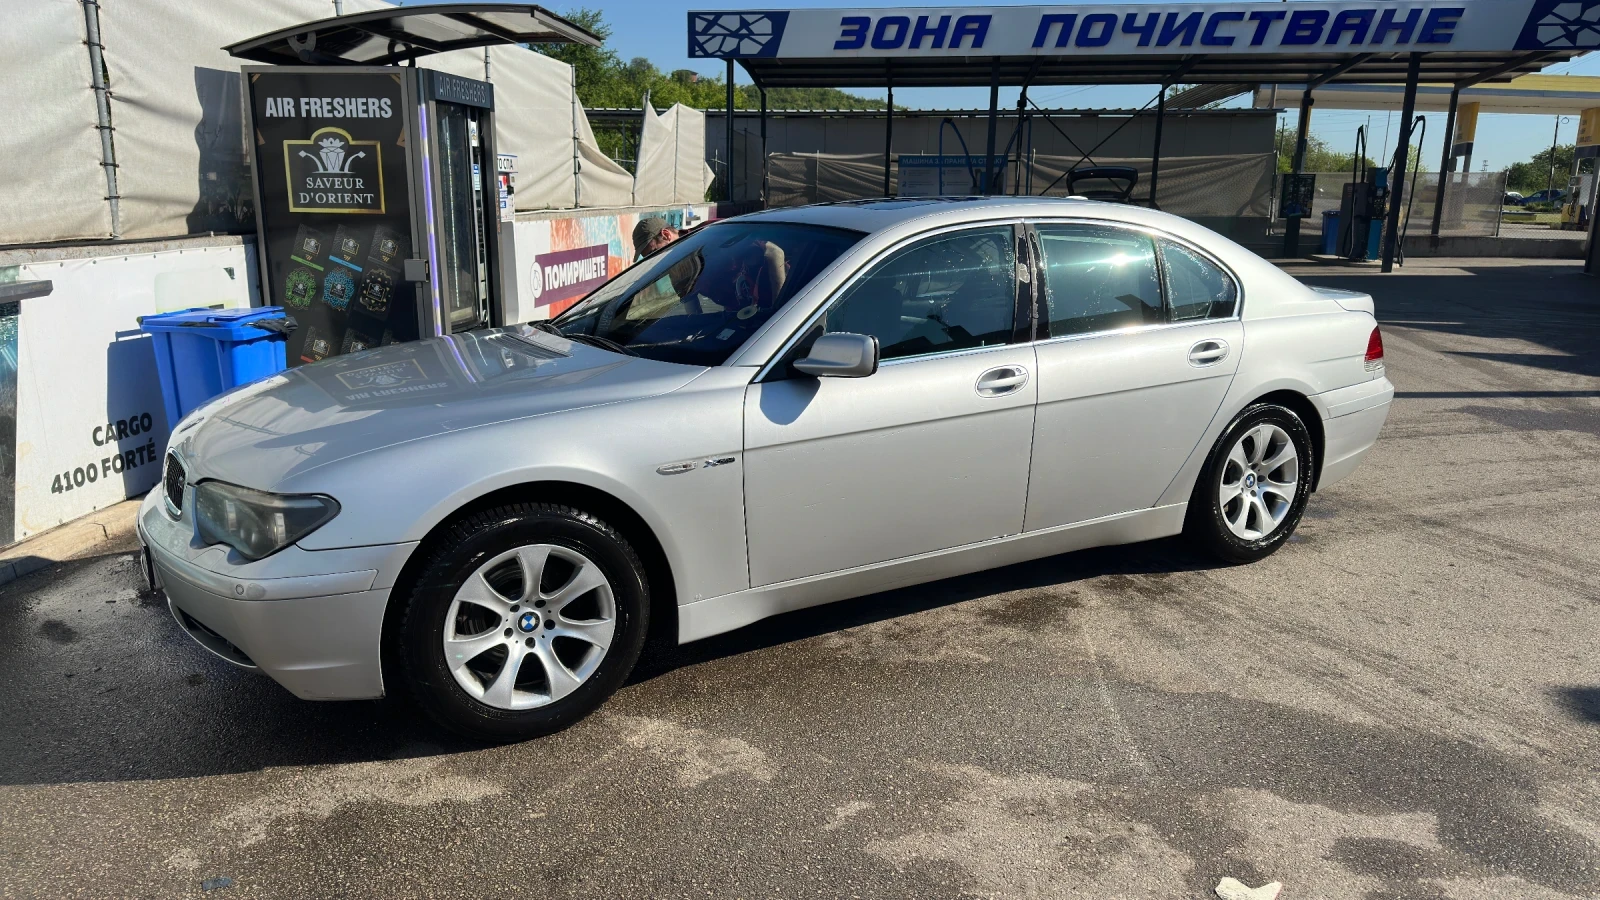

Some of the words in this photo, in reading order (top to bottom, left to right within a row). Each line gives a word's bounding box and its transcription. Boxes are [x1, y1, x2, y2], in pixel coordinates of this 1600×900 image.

[833, 14, 992, 50] ЗОНА
[1032, 8, 1465, 48] ПОЧИСТВАНЕ
[440, 76, 451, 97] AIR
[452, 79, 487, 104] FRESHERS
[265, 97, 295, 118] AIR
[300, 97, 393, 119] FRESHERS
[299, 192, 375, 205] D'ORIENT
[306, 177, 365, 190] SAVEUR
[544, 255, 606, 291] ПОМИРИШЕТЕ
[92, 412, 153, 447] CARGO
[51, 462, 98, 495] 4100
[101, 437, 156, 478] FORTÉ
